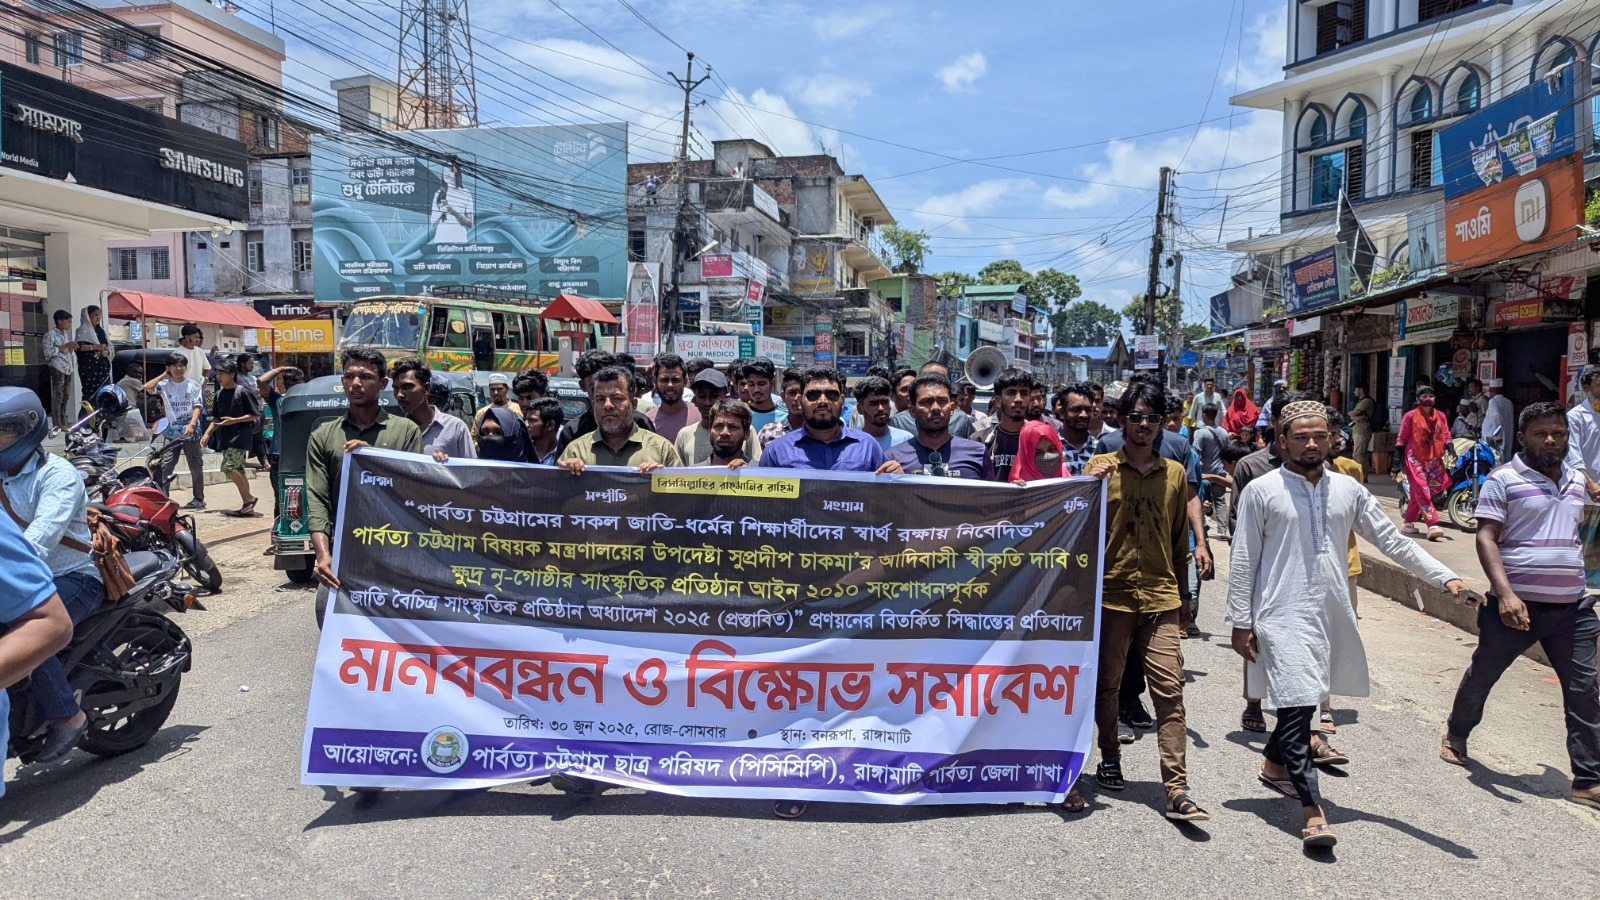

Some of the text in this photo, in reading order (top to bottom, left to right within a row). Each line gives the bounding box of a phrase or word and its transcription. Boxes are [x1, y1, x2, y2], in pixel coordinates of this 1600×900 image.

[17, 103, 83, 142] স্যামসাং
[19, 156, 39, 168] Media
[160, 147, 244, 187] SAMSUNG
[342, 179, 416, 200] শুধু টেলিটকে
[1455, 205, 1492, 243] শাওমি
[271, 304, 312, 316] Infinix
[263, 325, 325, 342] realme
[360, 471, 394, 488] শিক্ষা
[766, 482, 794, 493] রাহিম
[585, 488, 628, 503] সম্প্রীতি
[823, 500, 864, 513] সংগ্রাম
[1064, 496, 1089, 513] মুক্তি
[480, 506, 564, 529] চট্টগ্রামের
[570, 515, 621, 532] সকল
[626, 512, 735, 536] জাতি-ধর্মের
[740, 516, 846, 541] শিক্ষার্থীদের
[851, 522, 894, 543] স্বার্থ
[897, 527, 951, 543] রক্ষায়
[353, 523, 411, 548] পার্বত্য
[417, 527, 476, 553] চট্টগ্রাম
[481, 532, 542, 556] বিষয়ক
[547, 541, 646, 562] মন্ত্রণালয়ের
[652, 540, 723, 565] উপদেষ্টা
[728, 544, 795, 570] সুপ্রদীপ
[878, 546, 958, 570] আদিবাসী
[964, 545, 1025, 576] স্বীকৃতি
[1029, 548, 1070, 570] দাবি
[1075, 553, 1089, 568] ও
[450, 564, 990, 604] ক্ষুদ্র নৃ-গোষ্ঠীর সাংস্কৃতিক প্রতিষ্ঠান আইন ২০১০ সংশোধনপূর্বক
[349, 586, 389, 608] জাতি
[444, 593, 518, 621] সাংস্কৃতিক
[522, 597, 584, 620] প্রতিষ্ঠান
[588, 604, 657, 623] অধ্যাদেশ
[663, 610, 712, 627] ২০২৫
[809, 611, 875, 631] প্রণয়নের
[879, 608, 942, 631] বিতর্কিত
[946, 608, 1016, 631] সিদ্ধান্তের
[1019, 609, 1084, 632] প্রতিবাদে
[338, 638, 1081, 718] মানববন্ধন ও বিক্ষোভ সমাবেশ
[502, 716, 544, 732] তারিখ:
[549, 720, 569, 731] ৩০
[573, 719, 593, 734] জুন
[779, 728, 806, 745] স্থান:
[862, 727, 913, 745] রাঙ্গামাটি
[322, 743, 418, 767] আয়োজনে:
[472, 742, 538, 772] পার্বত্য
[543, 746, 606, 776] চট্টগ্রাম
[614, 754, 652, 776] ছাত্র
[657, 750, 724, 778] পরিষদ
[729, 752, 845, 784] (পিসিসিপি),
[853, 762, 924, 786] রাঙ্গামাটি
[928, 760, 974, 784] পার্বত্য
[980, 764, 1019, 783] জেলা
